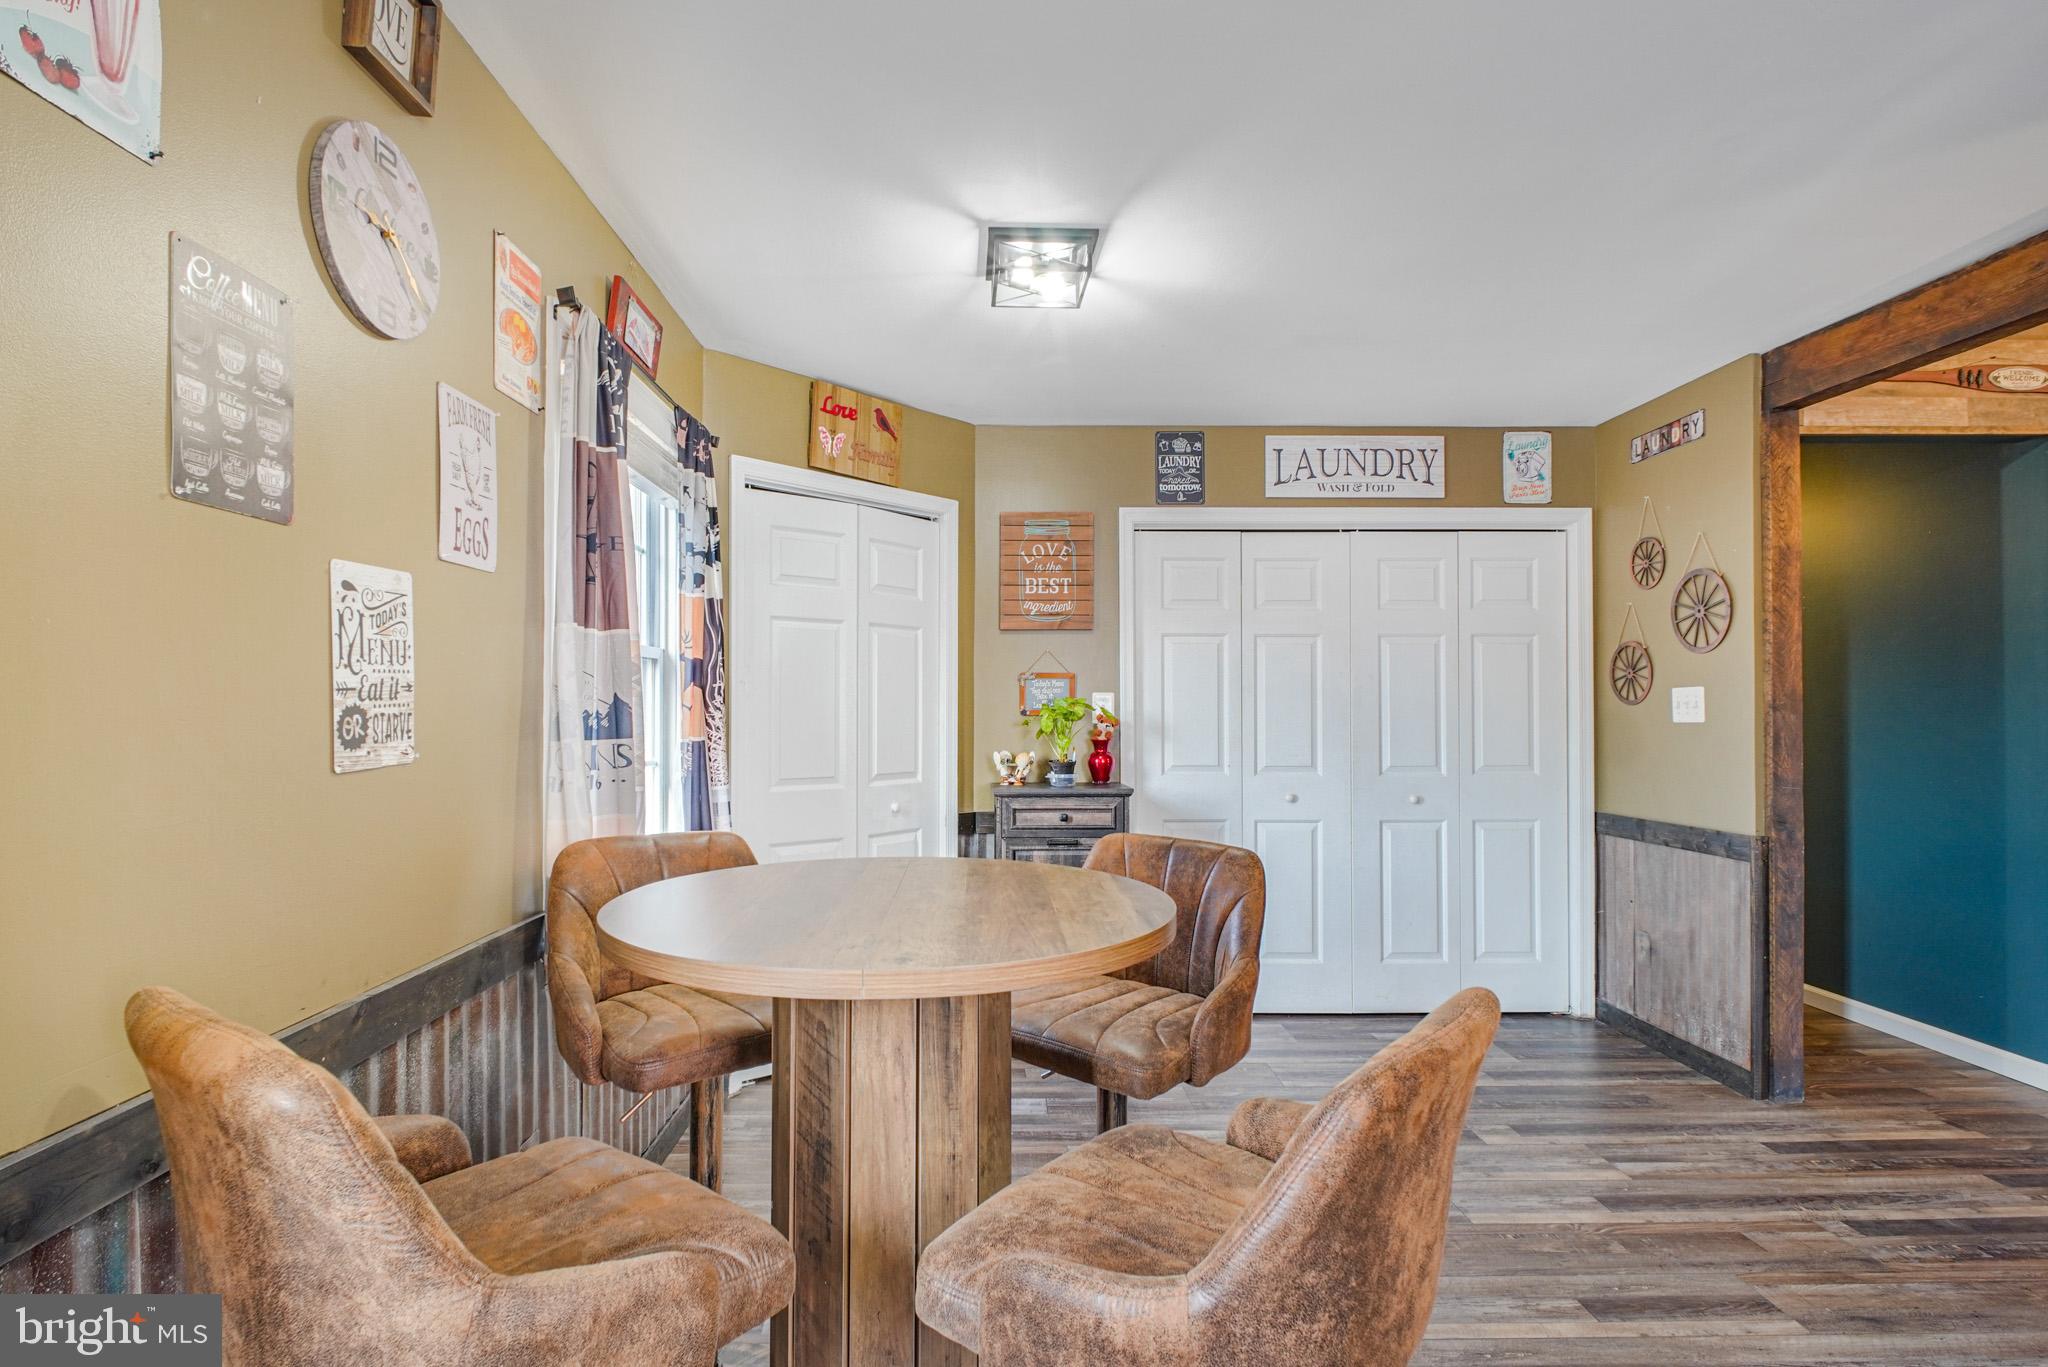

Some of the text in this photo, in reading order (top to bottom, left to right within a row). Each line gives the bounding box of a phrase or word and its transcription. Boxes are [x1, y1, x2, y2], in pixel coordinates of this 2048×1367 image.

[374, 136, 397, 180] 12
[187, 255, 279, 328] Coffee MENU
[446, 392, 492, 448] FARM FRESH
[820, 395, 858, 421] Love
[1505, 435, 1549, 451] Laundry
[1635, 418, 1699, 457] LAUNDRY
[1158, 455, 1202, 469] LAUNDRY
[1272, 447, 1439, 487] LAUNDRY
[1167, 476, 1191, 485] naked
[1317, 483, 1395, 493] WASH & FOLD
[453, 507, 489, 561] EGGS
[1020, 542, 1072, 564] LOVE
[1034, 561, 1063, 573] is the
[1025, 577, 1072, 594] BEST
[368, 602, 407, 630] TODAY'S
[1024, 600, 1074, 615] ingredient
[357, 674, 401, 703] Eat it
[342, 712, 412, 744] OR STARVE
